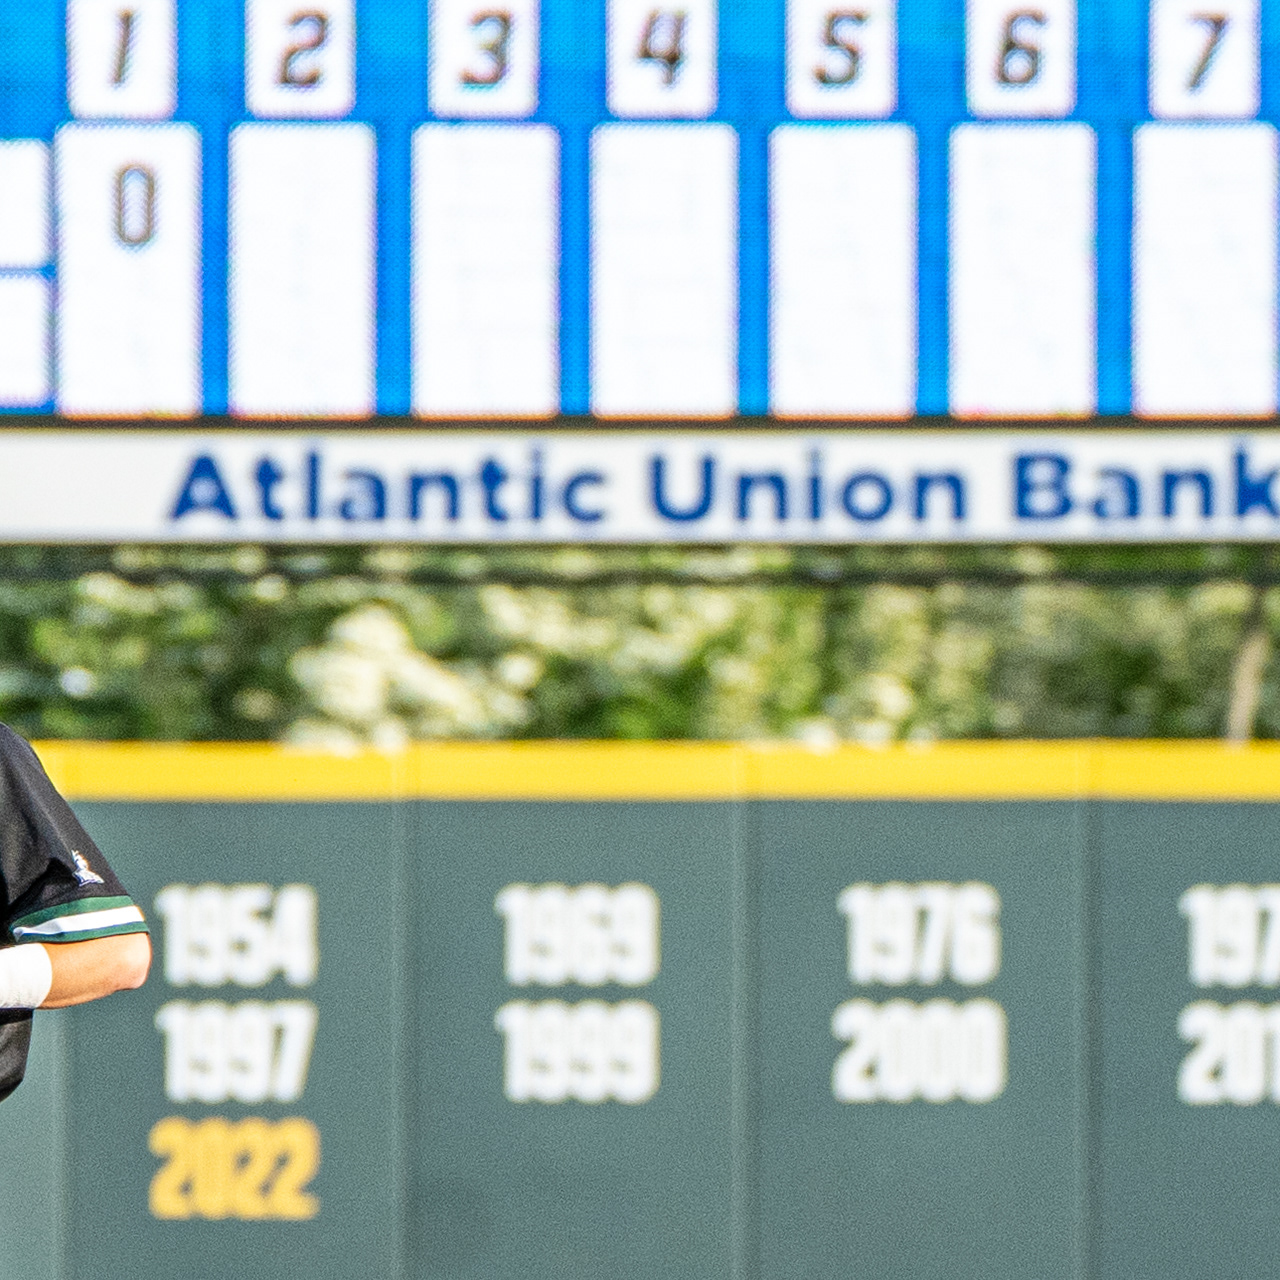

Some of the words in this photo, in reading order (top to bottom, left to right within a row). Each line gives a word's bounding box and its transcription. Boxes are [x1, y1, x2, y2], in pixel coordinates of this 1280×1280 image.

[108, 9, 137, 88] 1
[276, 9, 331, 90] 2
[458, 9, 515, 90] 3
[636, 10, 687, 88] 4
[812, 9, 869, 90] 5
[993, 9, 1049, 90] 6
[1185, 11, 1232, 93] 7
[110, 163, 159, 251] 0
[168, 450, 606, 525] Atlantic
[647, 450, 969, 525] Union
[1010, 447, 1280, 524] Bank
[155, 883, 319, 987] 1954
[495, 883, 659, 986] 1969
[837, 882, 1000, 985] 1976
[1178, 883, 1280, 988] 197
[155, 1000, 318, 1103] 1997
[495, 1000, 659, 1104] 1999
[831, 999, 1006, 1103] 2000
[148, 1117, 320, 1221] 2022
